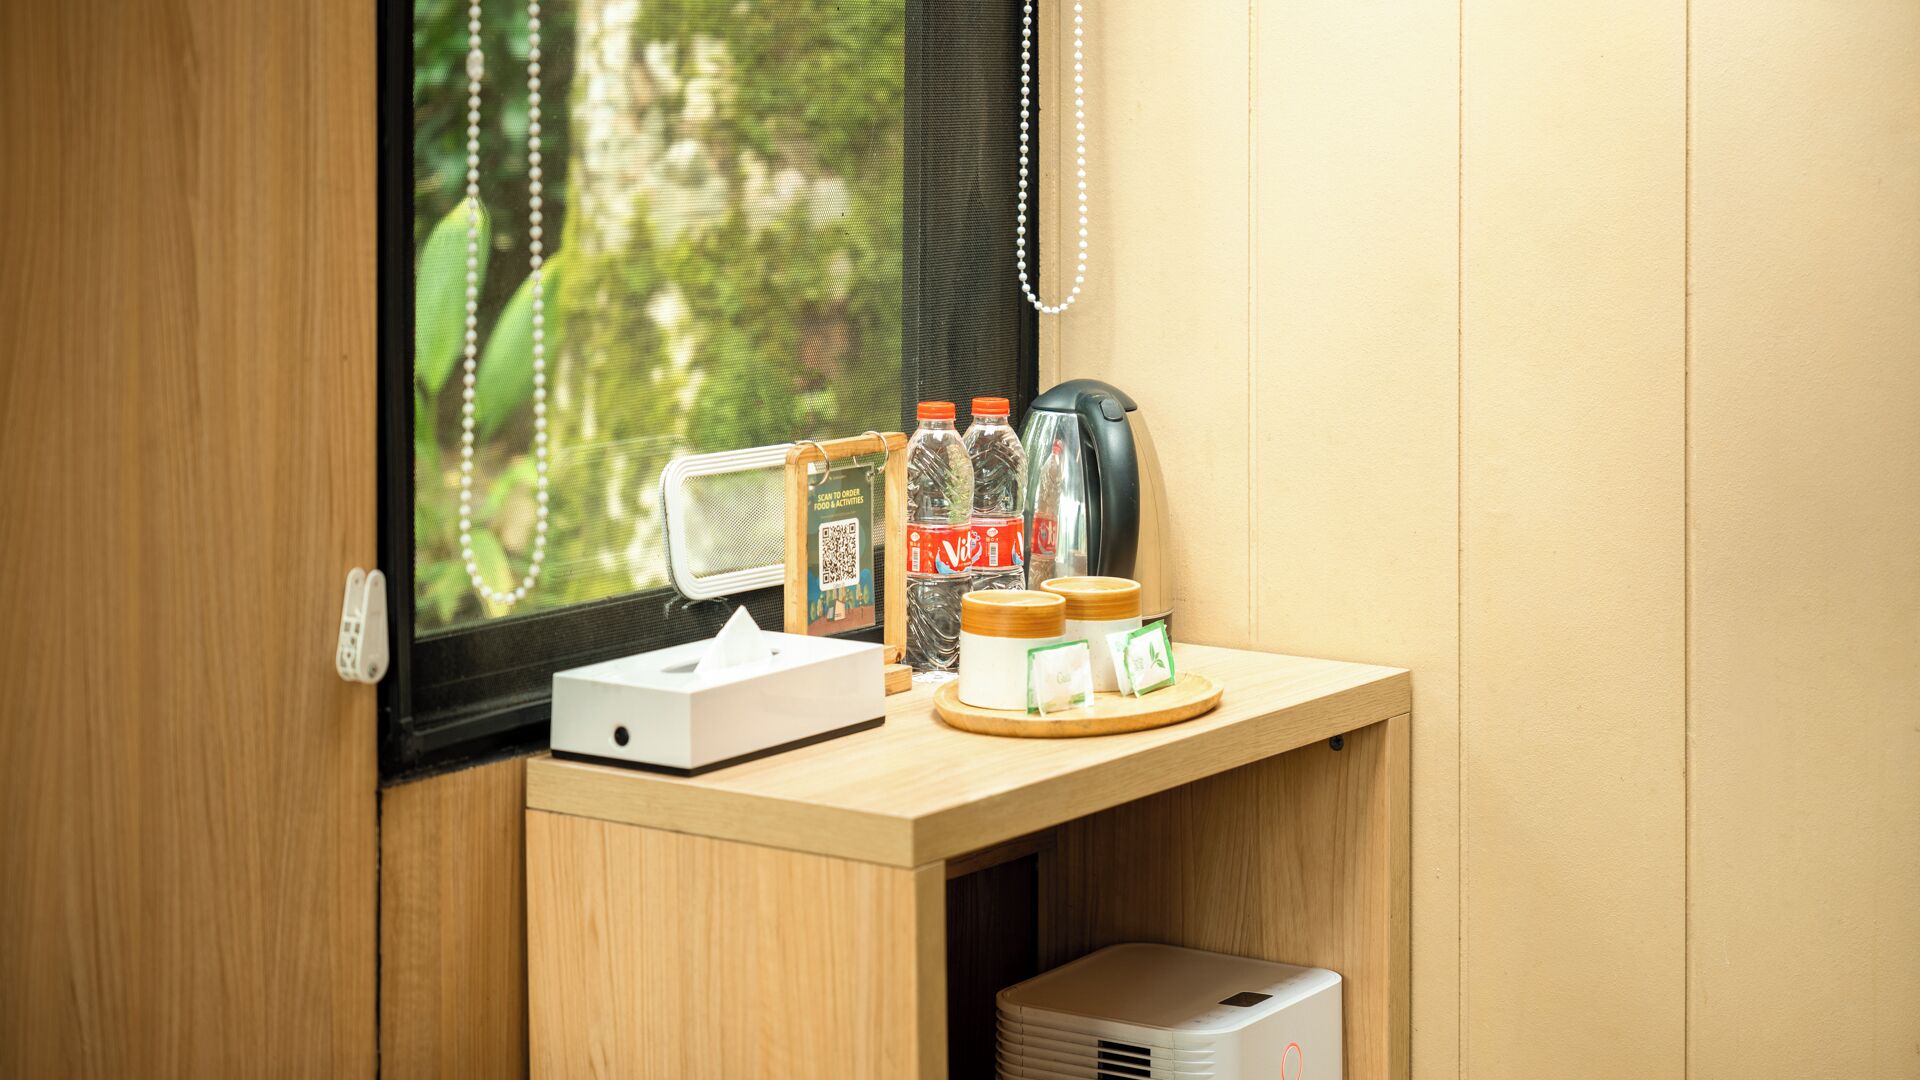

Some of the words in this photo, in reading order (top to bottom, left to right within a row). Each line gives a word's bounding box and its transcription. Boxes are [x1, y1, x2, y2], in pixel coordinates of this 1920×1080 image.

[817, 493, 833, 502] SCAN
[833, 491, 842, 500] TO
[841, 488, 861, 499] ORDER
[813, 502, 830, 511] FOOD
[830, 500, 835, 508] &
[836, 496, 864, 508] ACTIVITIES
